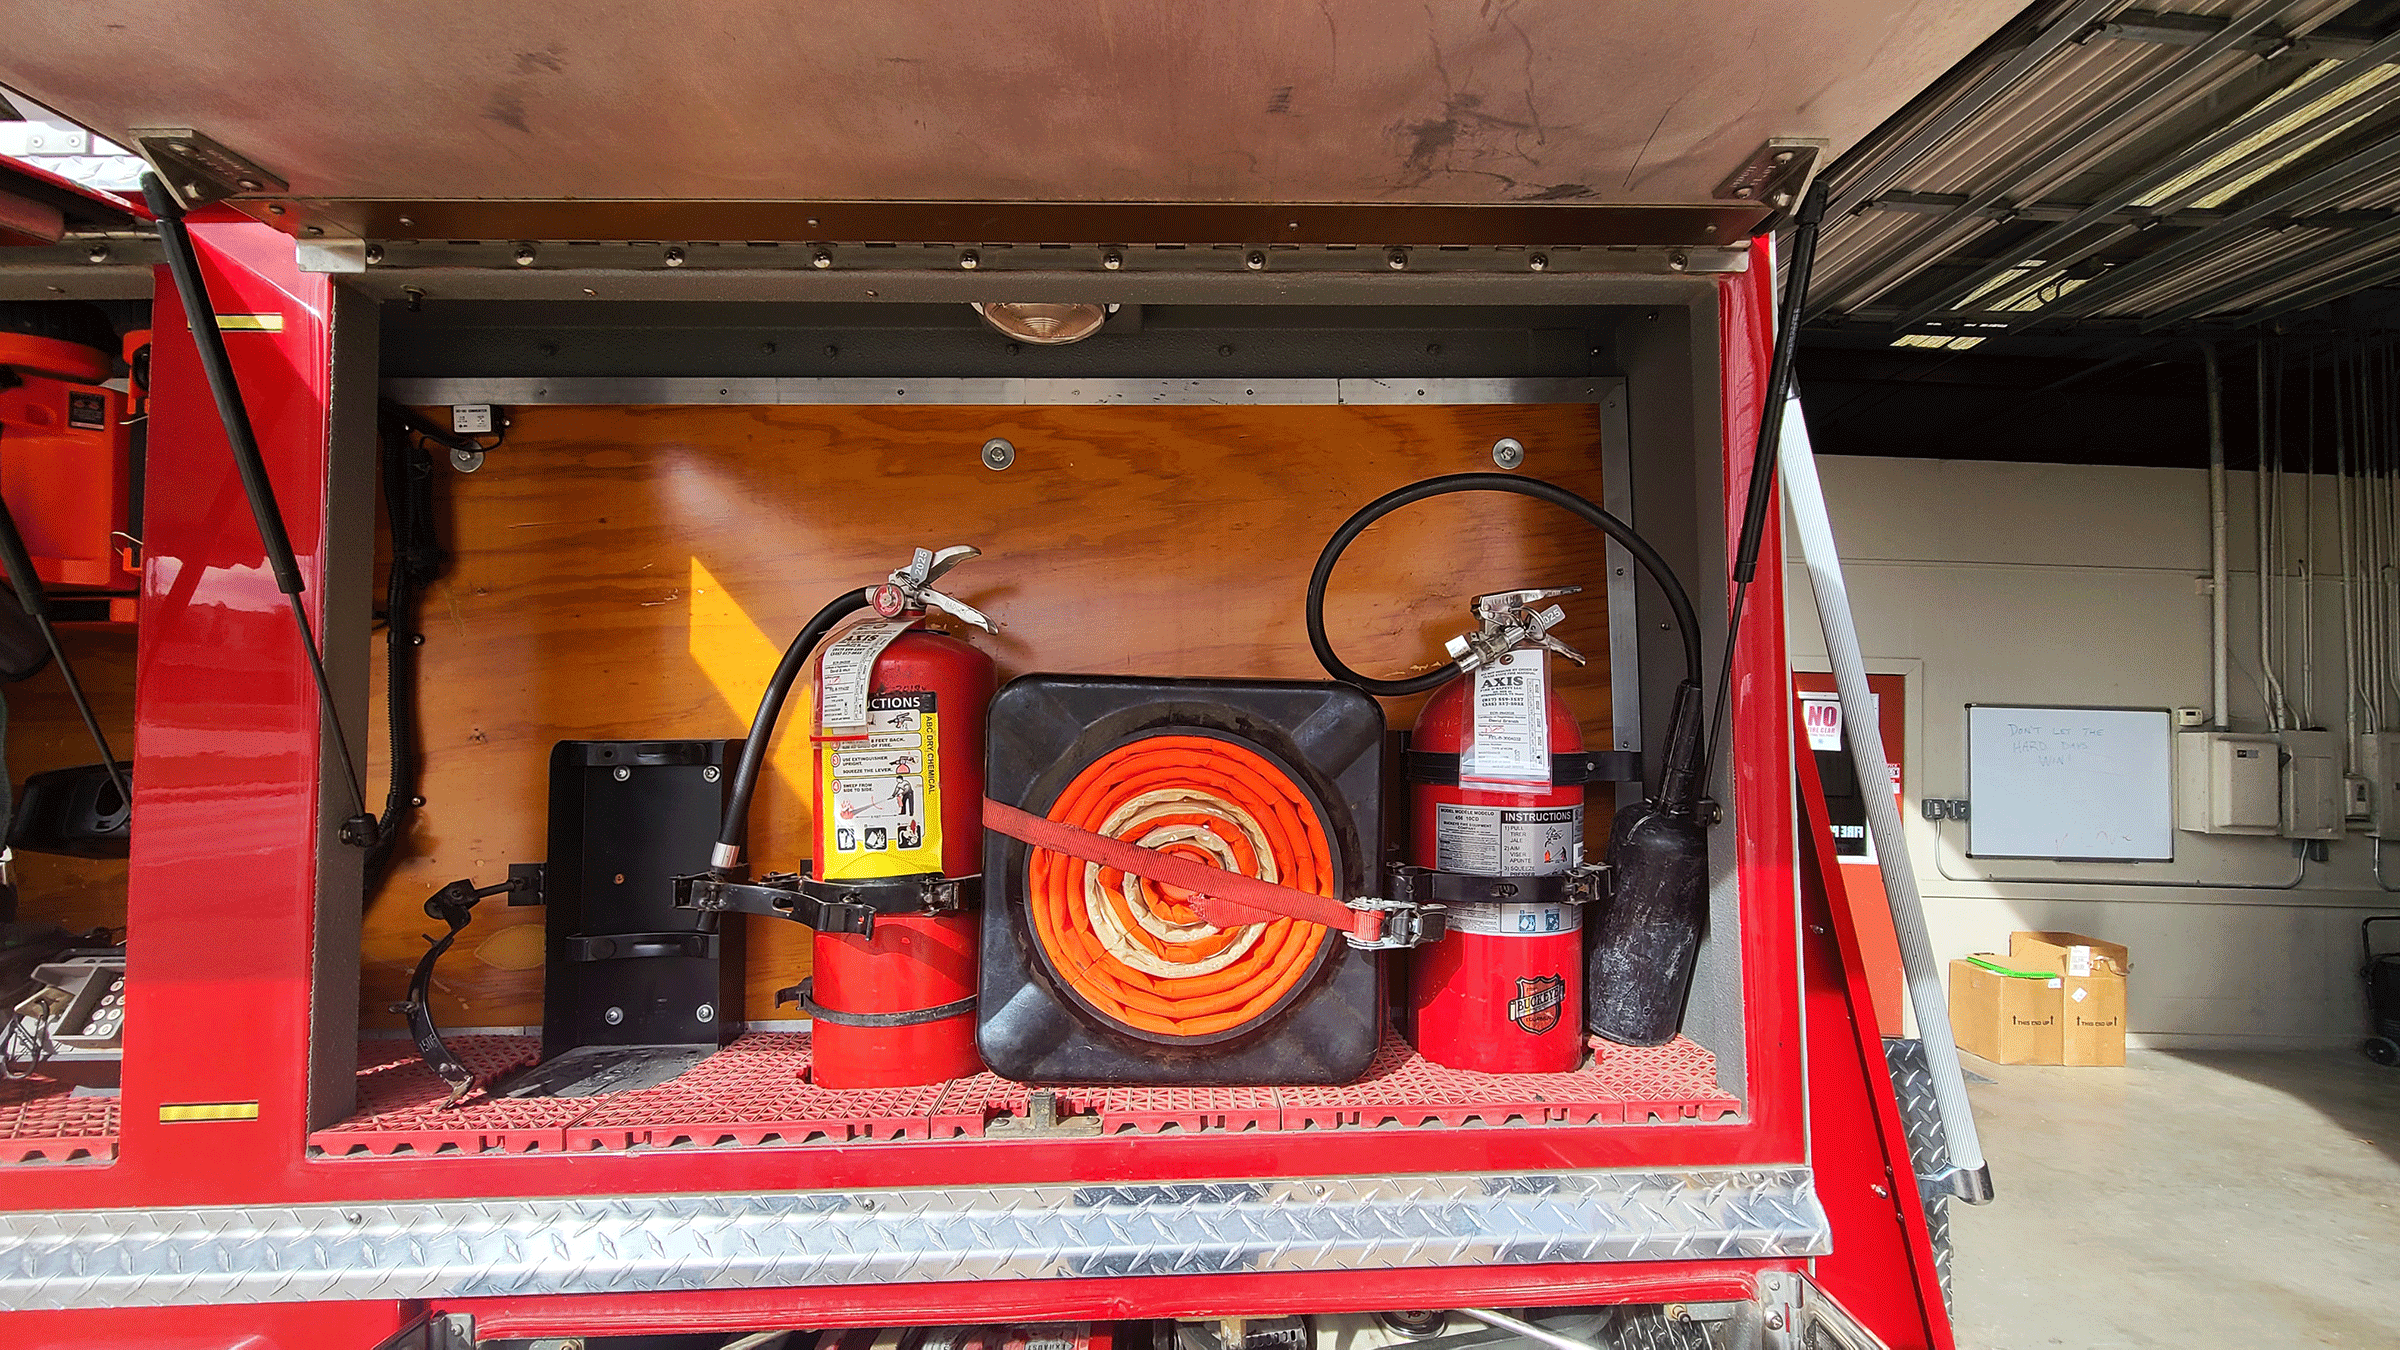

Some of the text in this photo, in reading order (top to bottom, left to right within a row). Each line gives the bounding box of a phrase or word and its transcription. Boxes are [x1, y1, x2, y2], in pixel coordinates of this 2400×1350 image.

[915, 550, 928, 576] 2025
[1541, 608, 1561, 624] 025
[839, 634, 879, 644] AXIS
[1481, 676, 1524, 688] AXIS
[1808, 706, 1837, 726] NO
[2008, 724, 2103, 736] DON'T LET THE
[2012, 741, 2047, 754] HARD
[833, 754, 838, 765] 3
[1505, 811, 1571, 822] INSTRUCTIONS
[1518, 986, 1559, 1012] BUCKEYE
